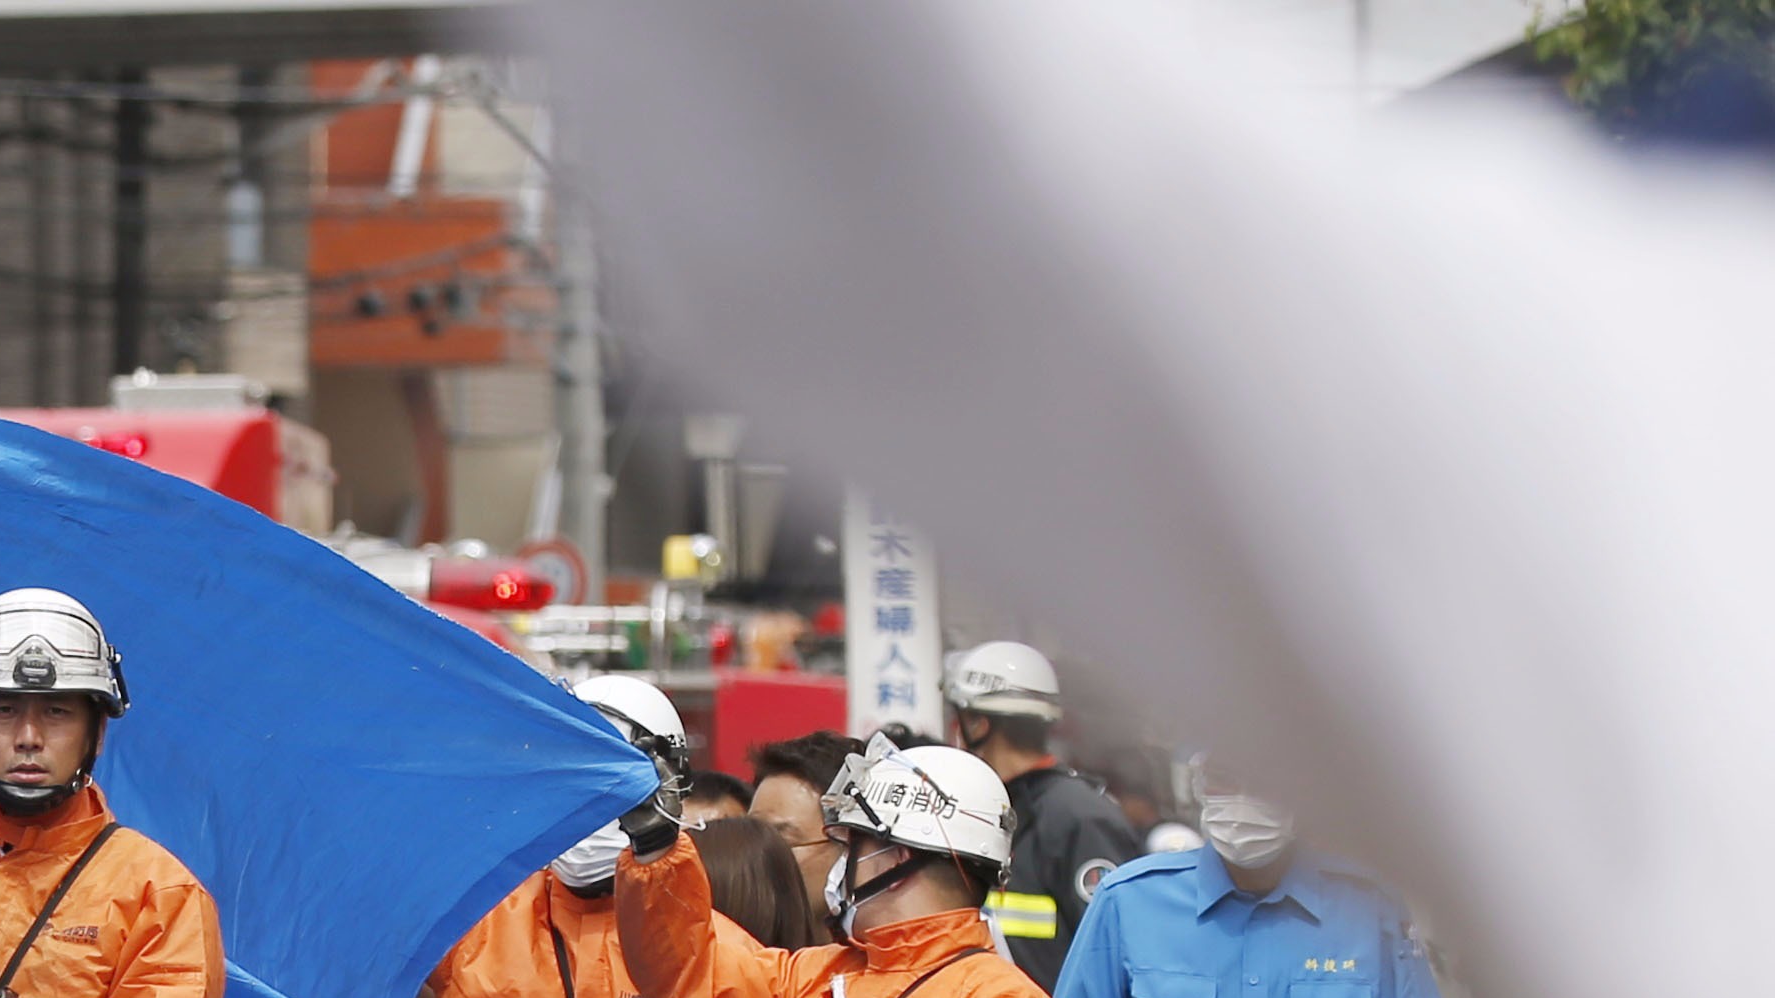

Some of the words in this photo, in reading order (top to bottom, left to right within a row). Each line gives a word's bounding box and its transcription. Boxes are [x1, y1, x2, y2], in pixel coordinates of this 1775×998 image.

[867, 505, 917, 710] 木産婦人科
[865, 780, 960, 820] 川崎消防
